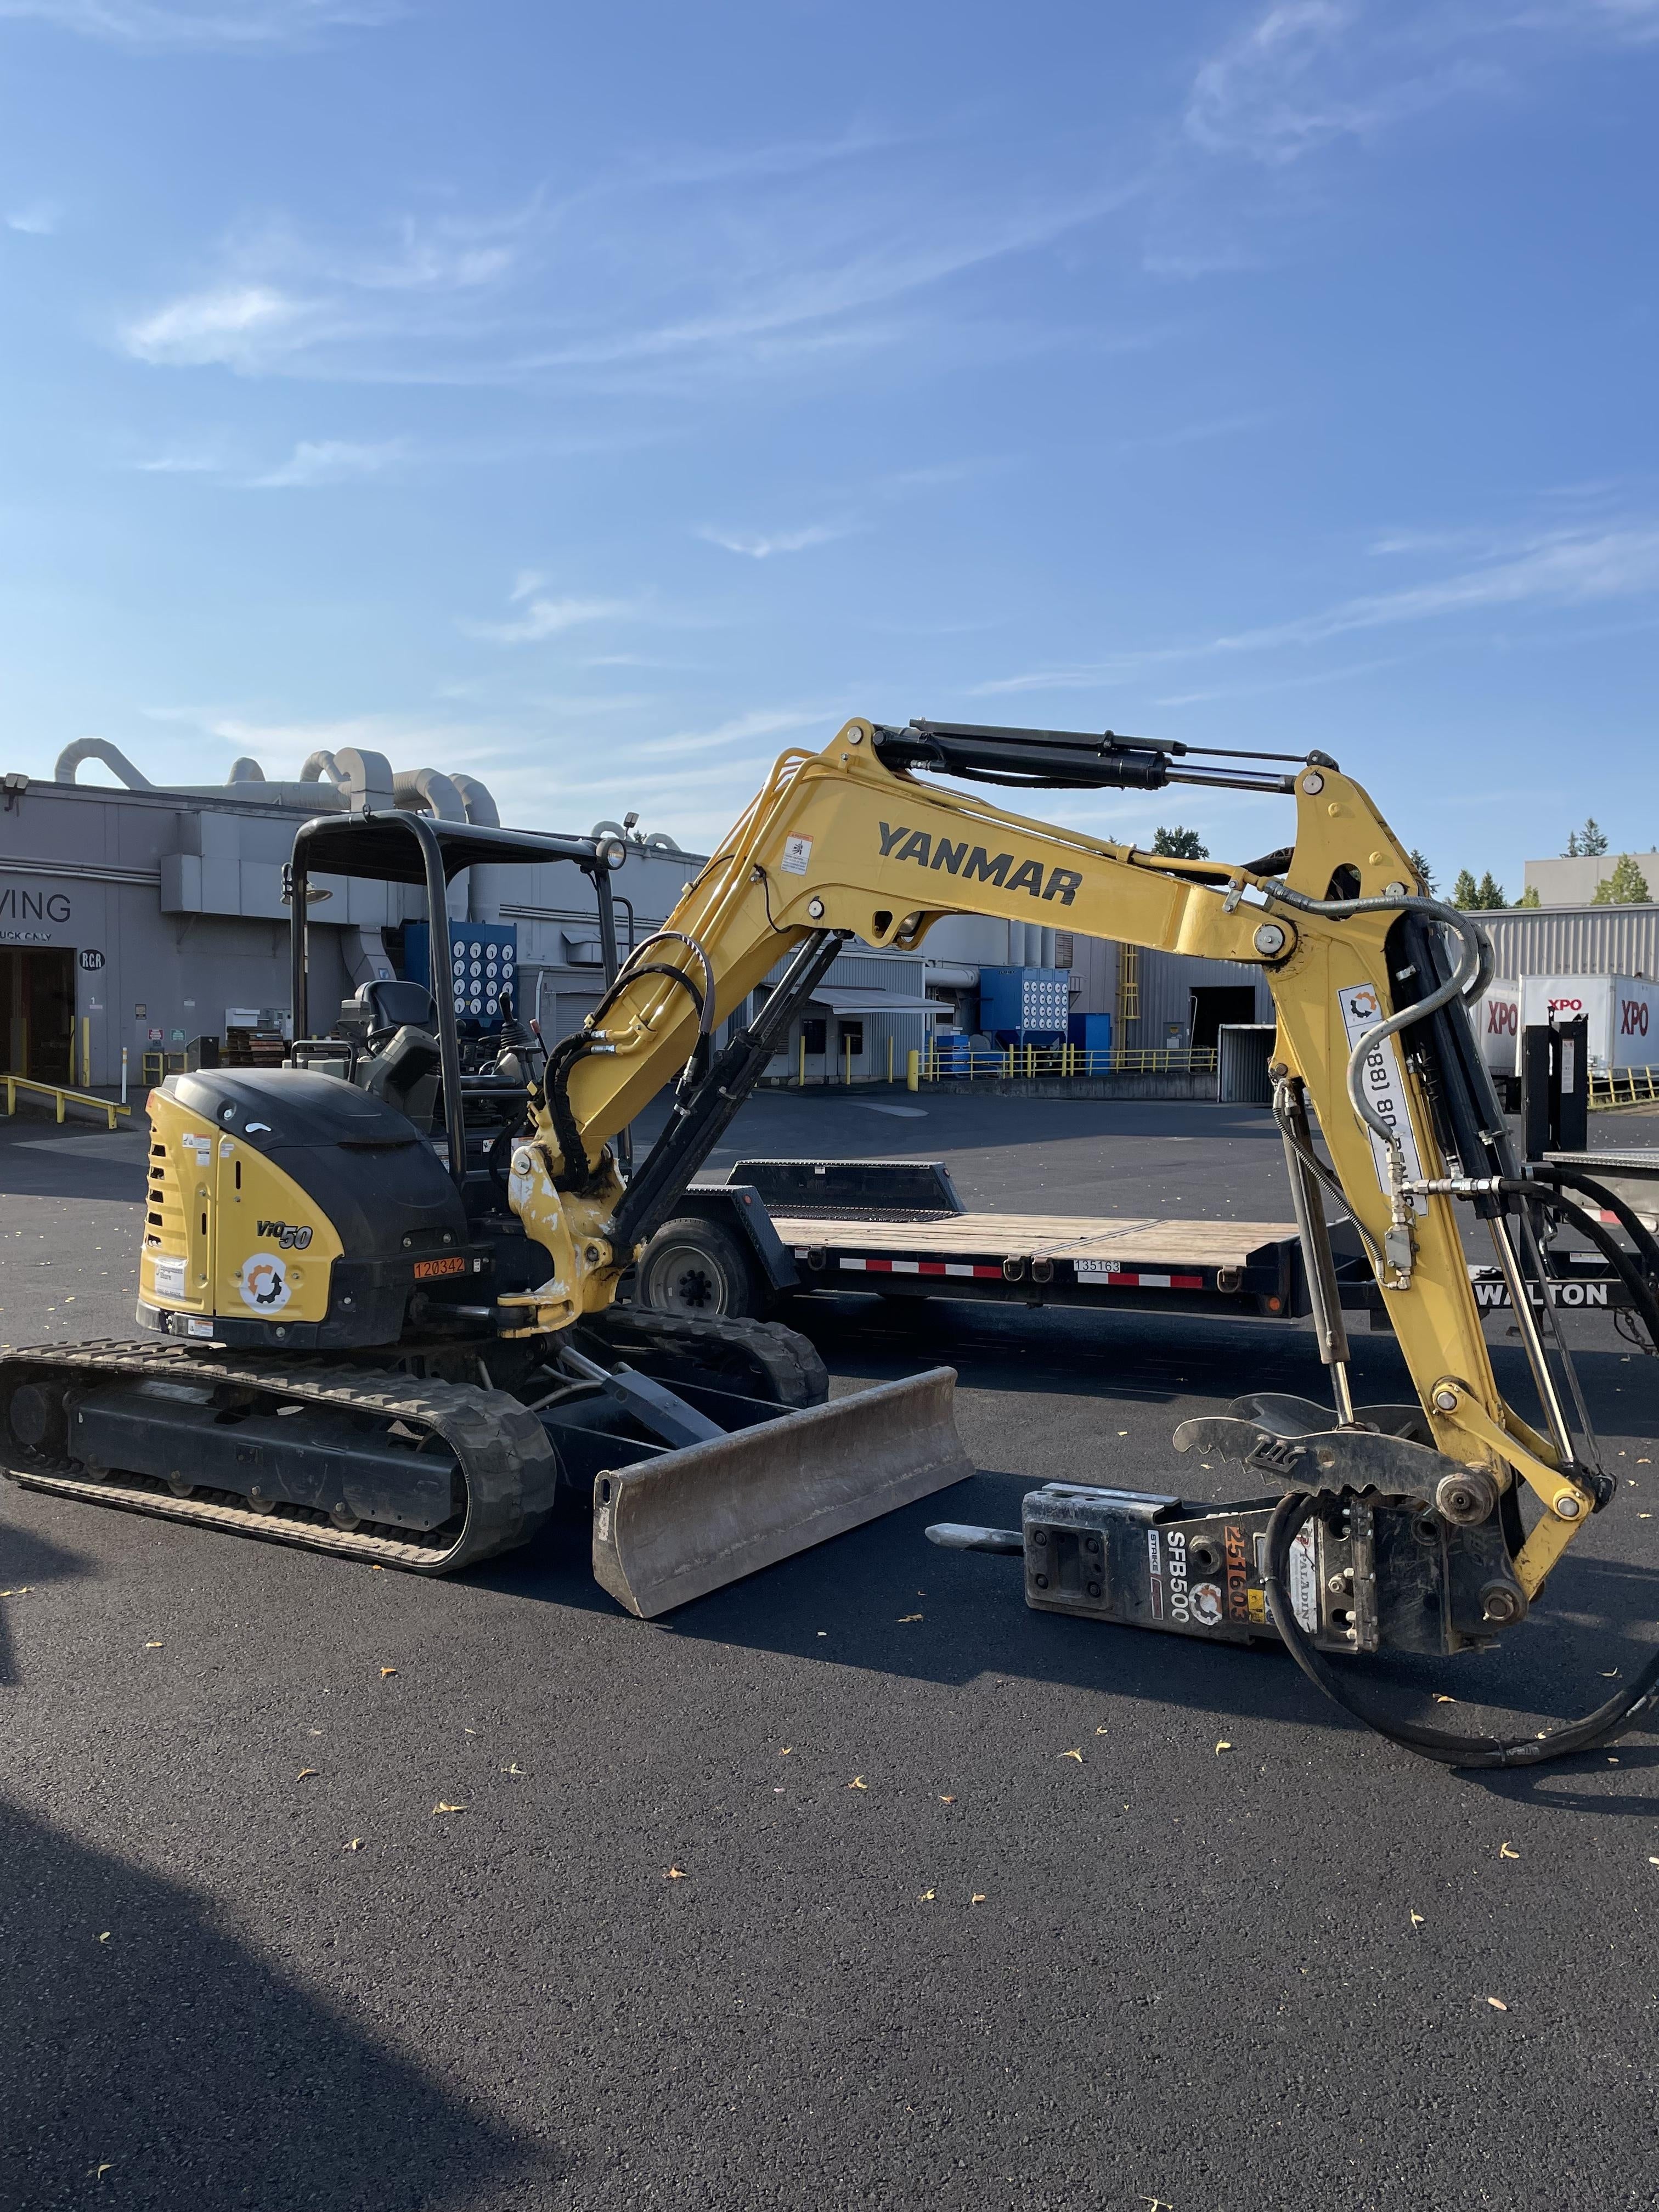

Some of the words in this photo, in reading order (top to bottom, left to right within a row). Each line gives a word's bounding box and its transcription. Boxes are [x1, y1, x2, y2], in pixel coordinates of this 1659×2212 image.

[879, 821, 1082, 906] YANMAR
[1487, 1000, 1518, 1036] XPO
[1548, 999, 1582, 1011] XPO
[1621, 1000, 1649, 1036] XPO
[415, 1257, 464, 1277] 120342
[1075, 1260, 1120, 1272] 135163
[1474, 1283, 1607, 1305] WLTON
[1150, 1533, 1159, 1572] STRIKE
[1167, 1531, 1190, 1623] SFB500
[1227, 1526, 1249, 1623] 251603
[1300, 1553, 1310, 1621] PALADIN
